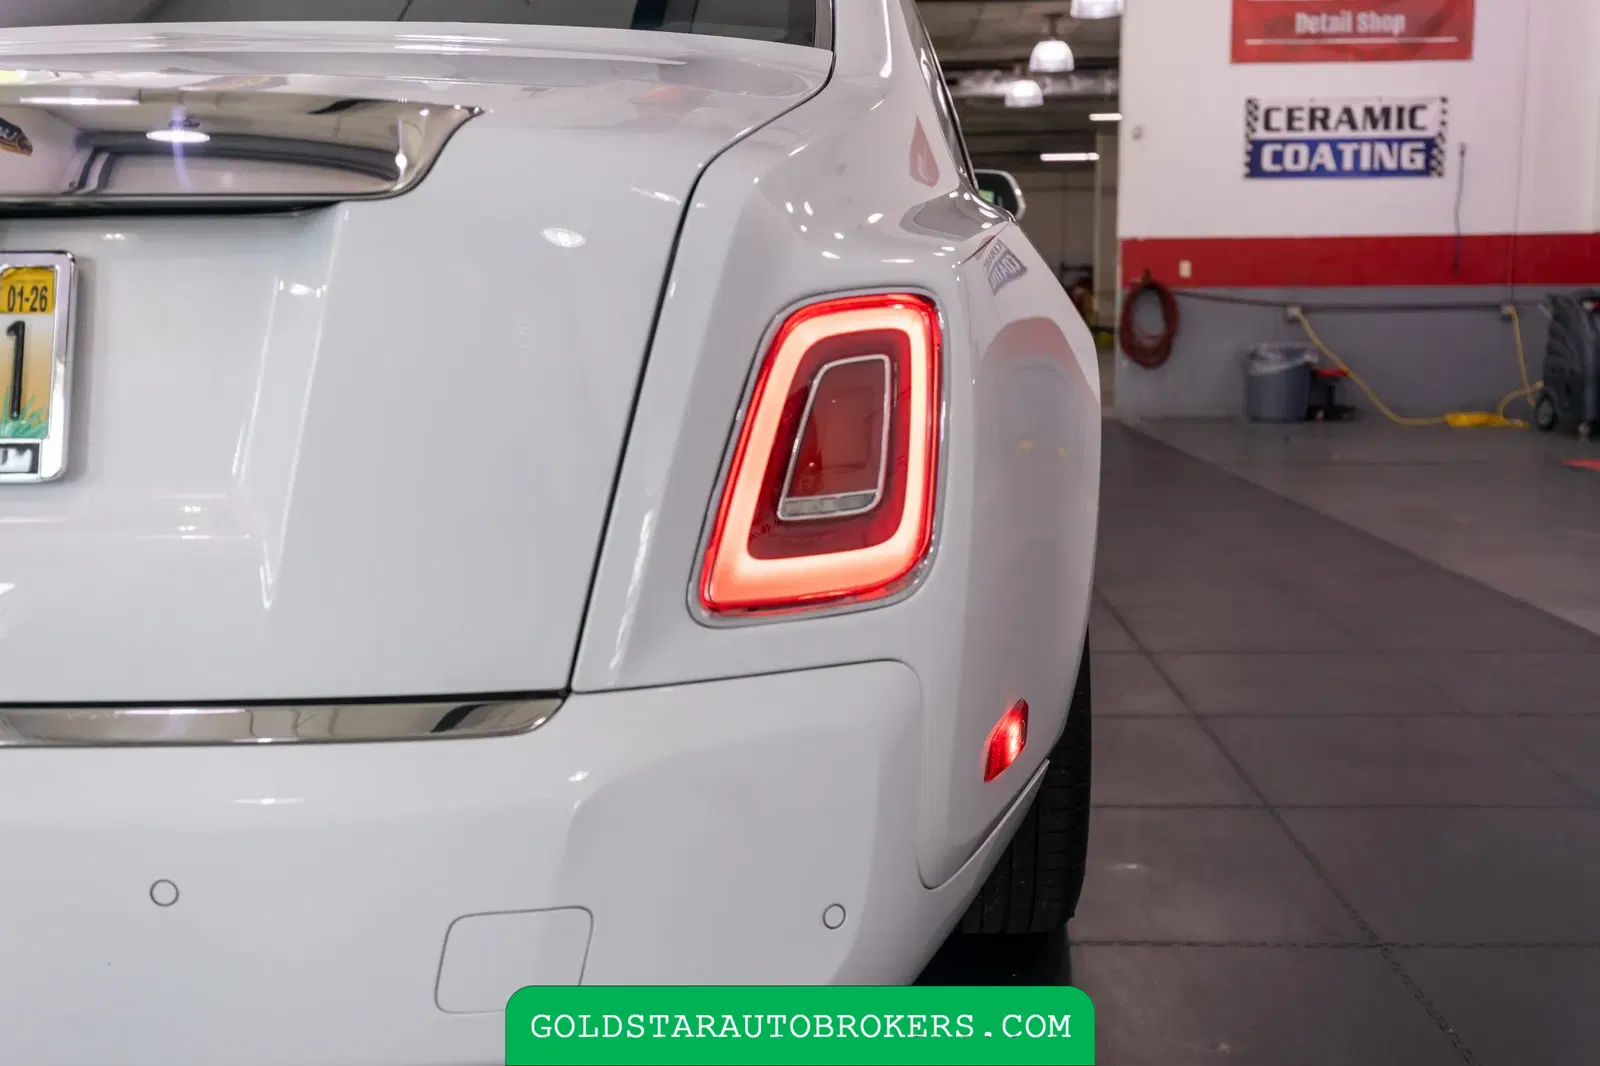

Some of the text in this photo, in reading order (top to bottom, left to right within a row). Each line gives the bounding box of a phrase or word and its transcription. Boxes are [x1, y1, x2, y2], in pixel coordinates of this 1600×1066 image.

[1295, 11, 1406, 35] Detail Shop
[1263, 104, 1428, 132] CERAMIC
[1260, 141, 1426, 172] COATING
[7, 284, 48, 312] 01-26
